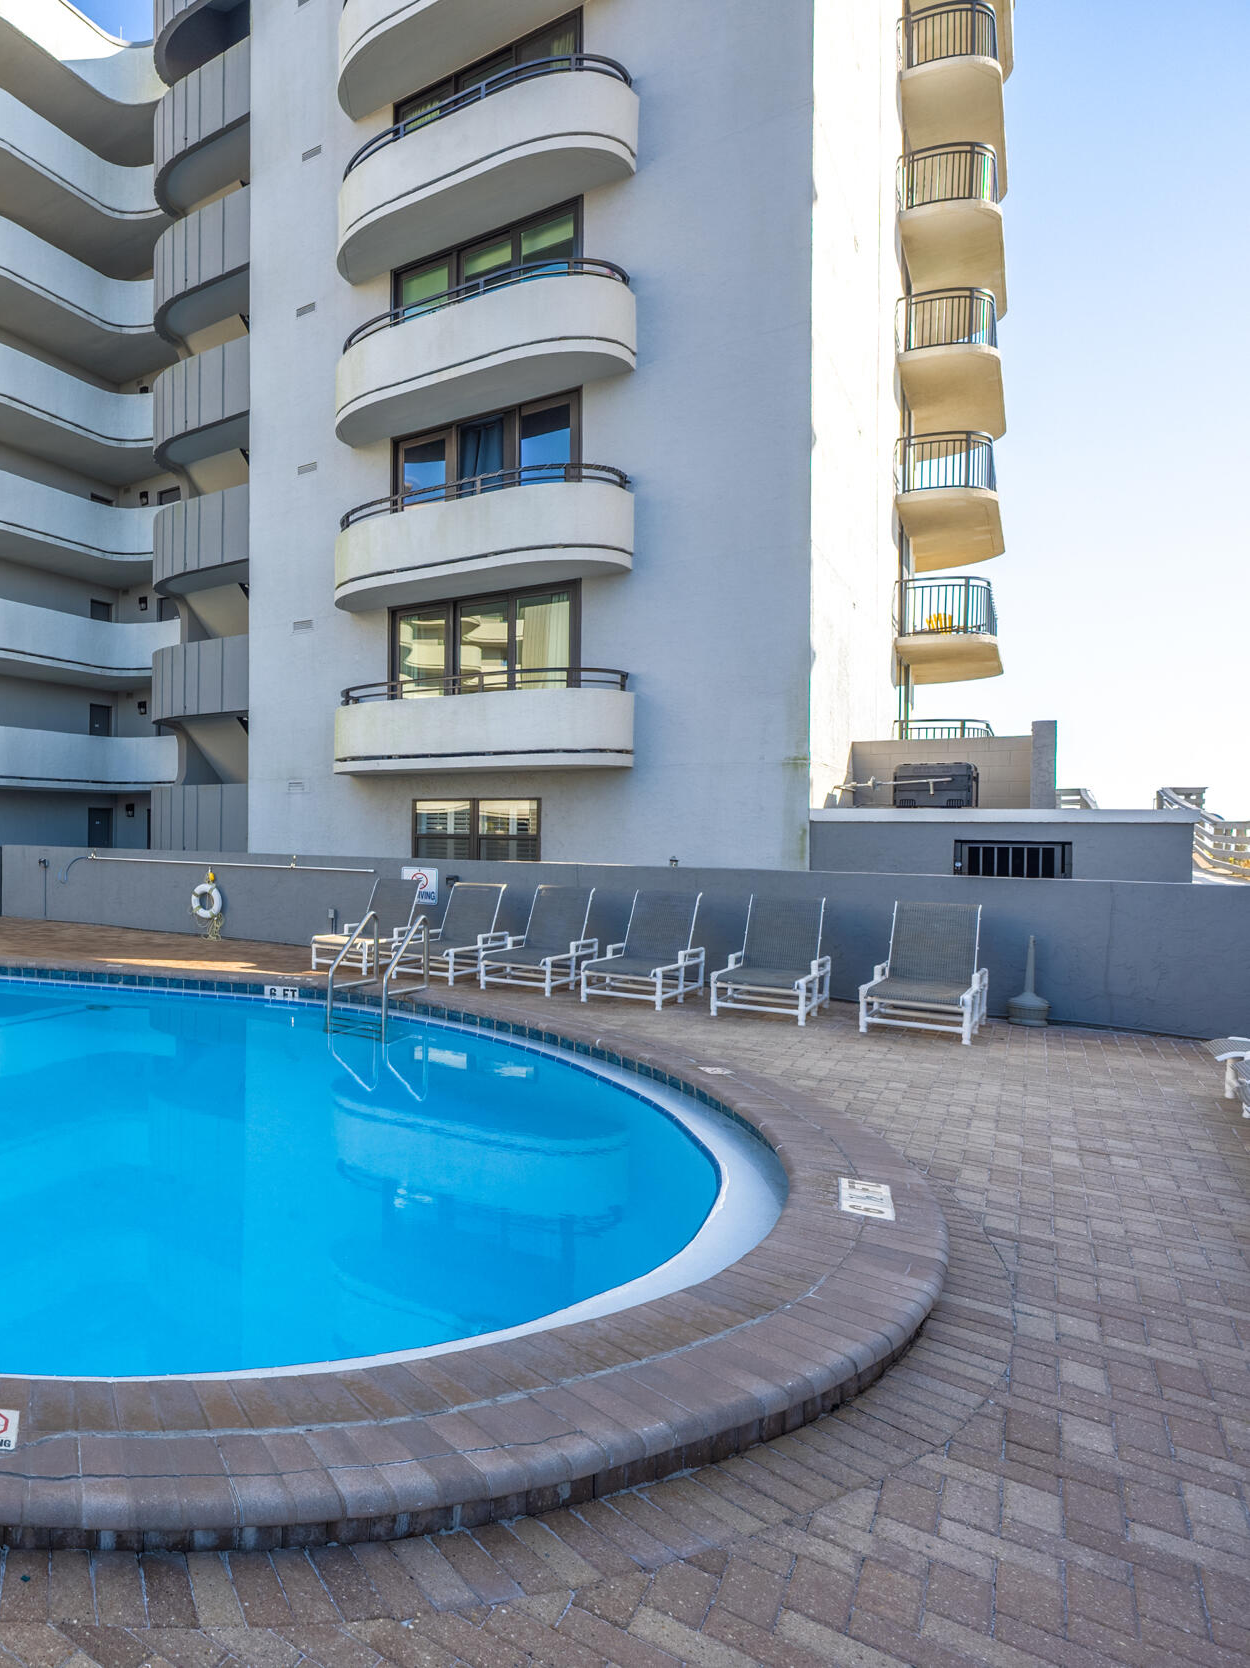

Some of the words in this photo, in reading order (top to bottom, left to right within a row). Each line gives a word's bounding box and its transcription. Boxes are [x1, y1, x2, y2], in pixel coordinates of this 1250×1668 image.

[417, 891, 436, 900] IVING
[269, 987, 277, 997] 6
[282, 988, 297, 998] FT
